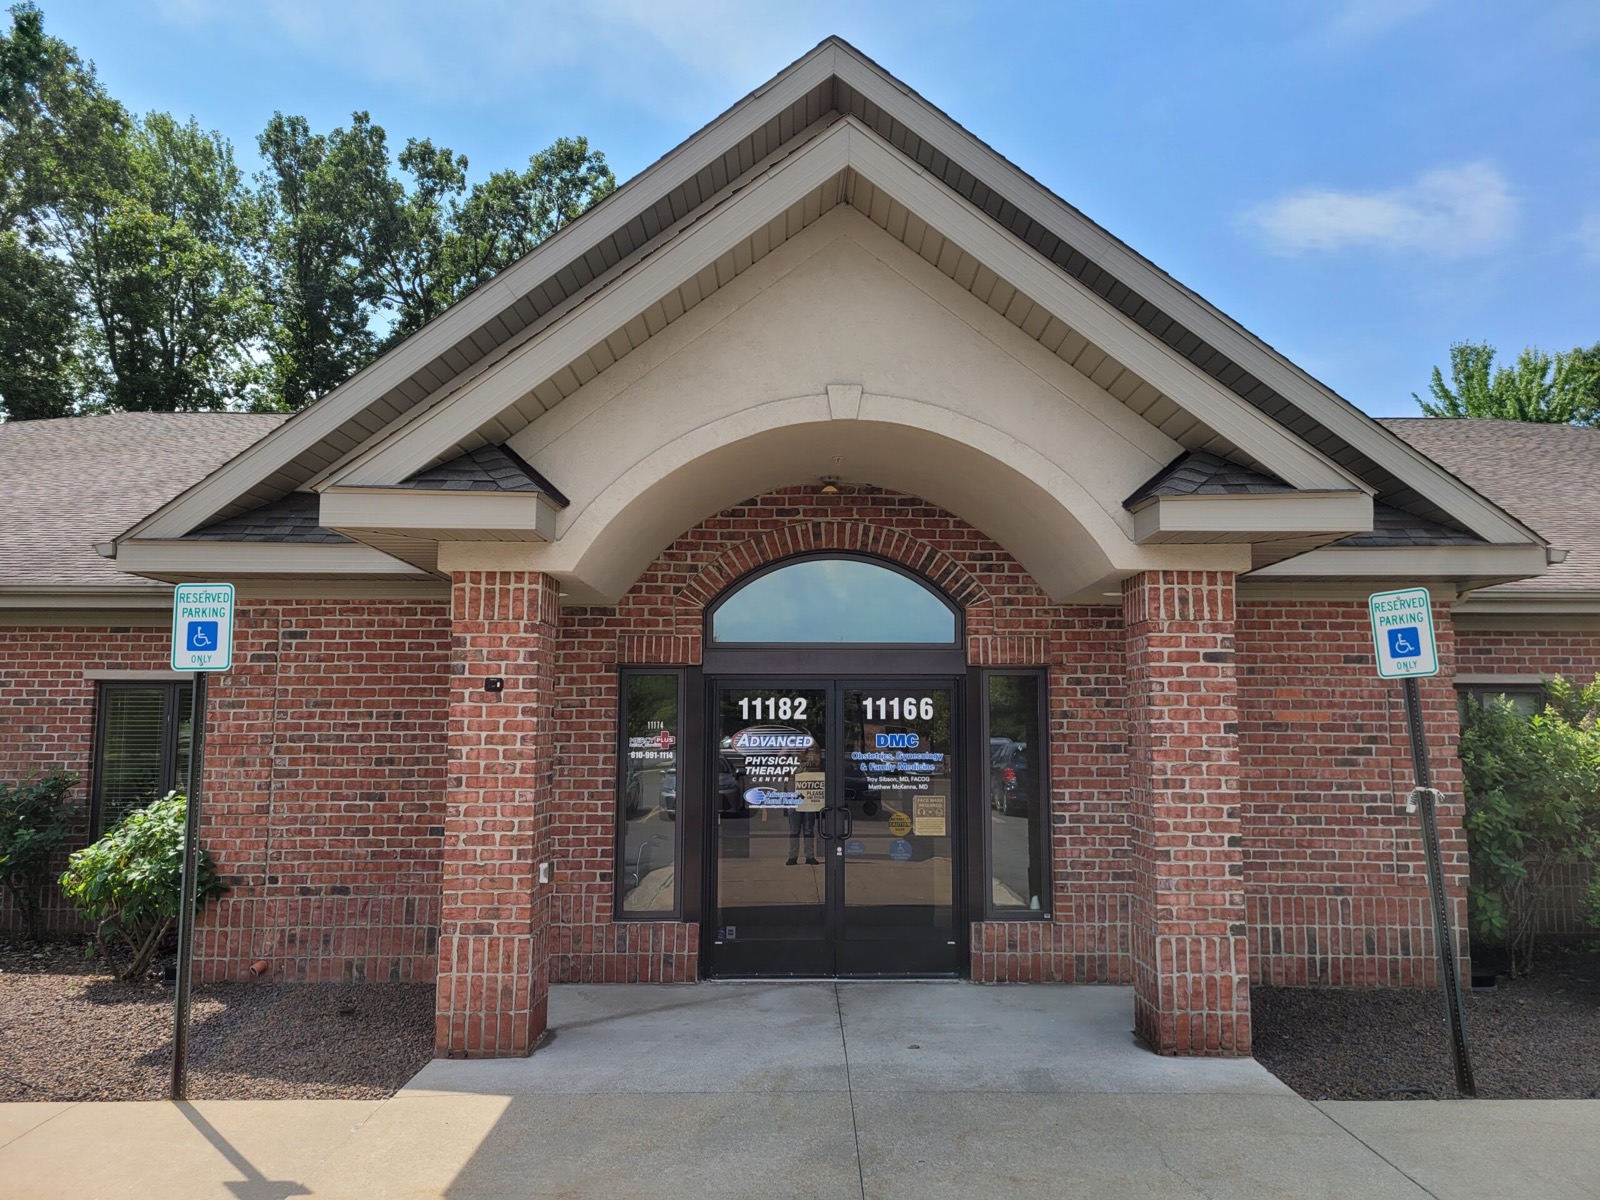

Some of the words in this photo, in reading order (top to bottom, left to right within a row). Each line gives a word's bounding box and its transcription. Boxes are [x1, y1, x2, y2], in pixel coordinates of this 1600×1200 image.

[180, 593, 229, 603] RESERVED
[1374, 597, 1424, 612] RESERVED
[182, 607, 226, 618] PARKING
[1380, 612, 1423, 626] PARKING
[191, 655, 212, 663] ONLY
[1397, 661, 1417, 669] ONLY
[738, 697, 807, 720] 11182
[862, 697, 934, 720] 11166
[648, 721, 663, 729] 11174
[736, 733, 814, 747] ADVANCED
[876, 733, 919, 747] DMC
[744, 756, 801, 765] PHYSICAL
[851, 752, 895, 760] Obstetrics,
[896, 752, 944, 761] Gynecology
[745, 766, 798, 775] THERAPY
[860, 763, 868, 771] &
[868, 762, 896, 771] Family
[897, 762, 936, 771] Medicine
[795, 781, 824, 789] NOTICE
